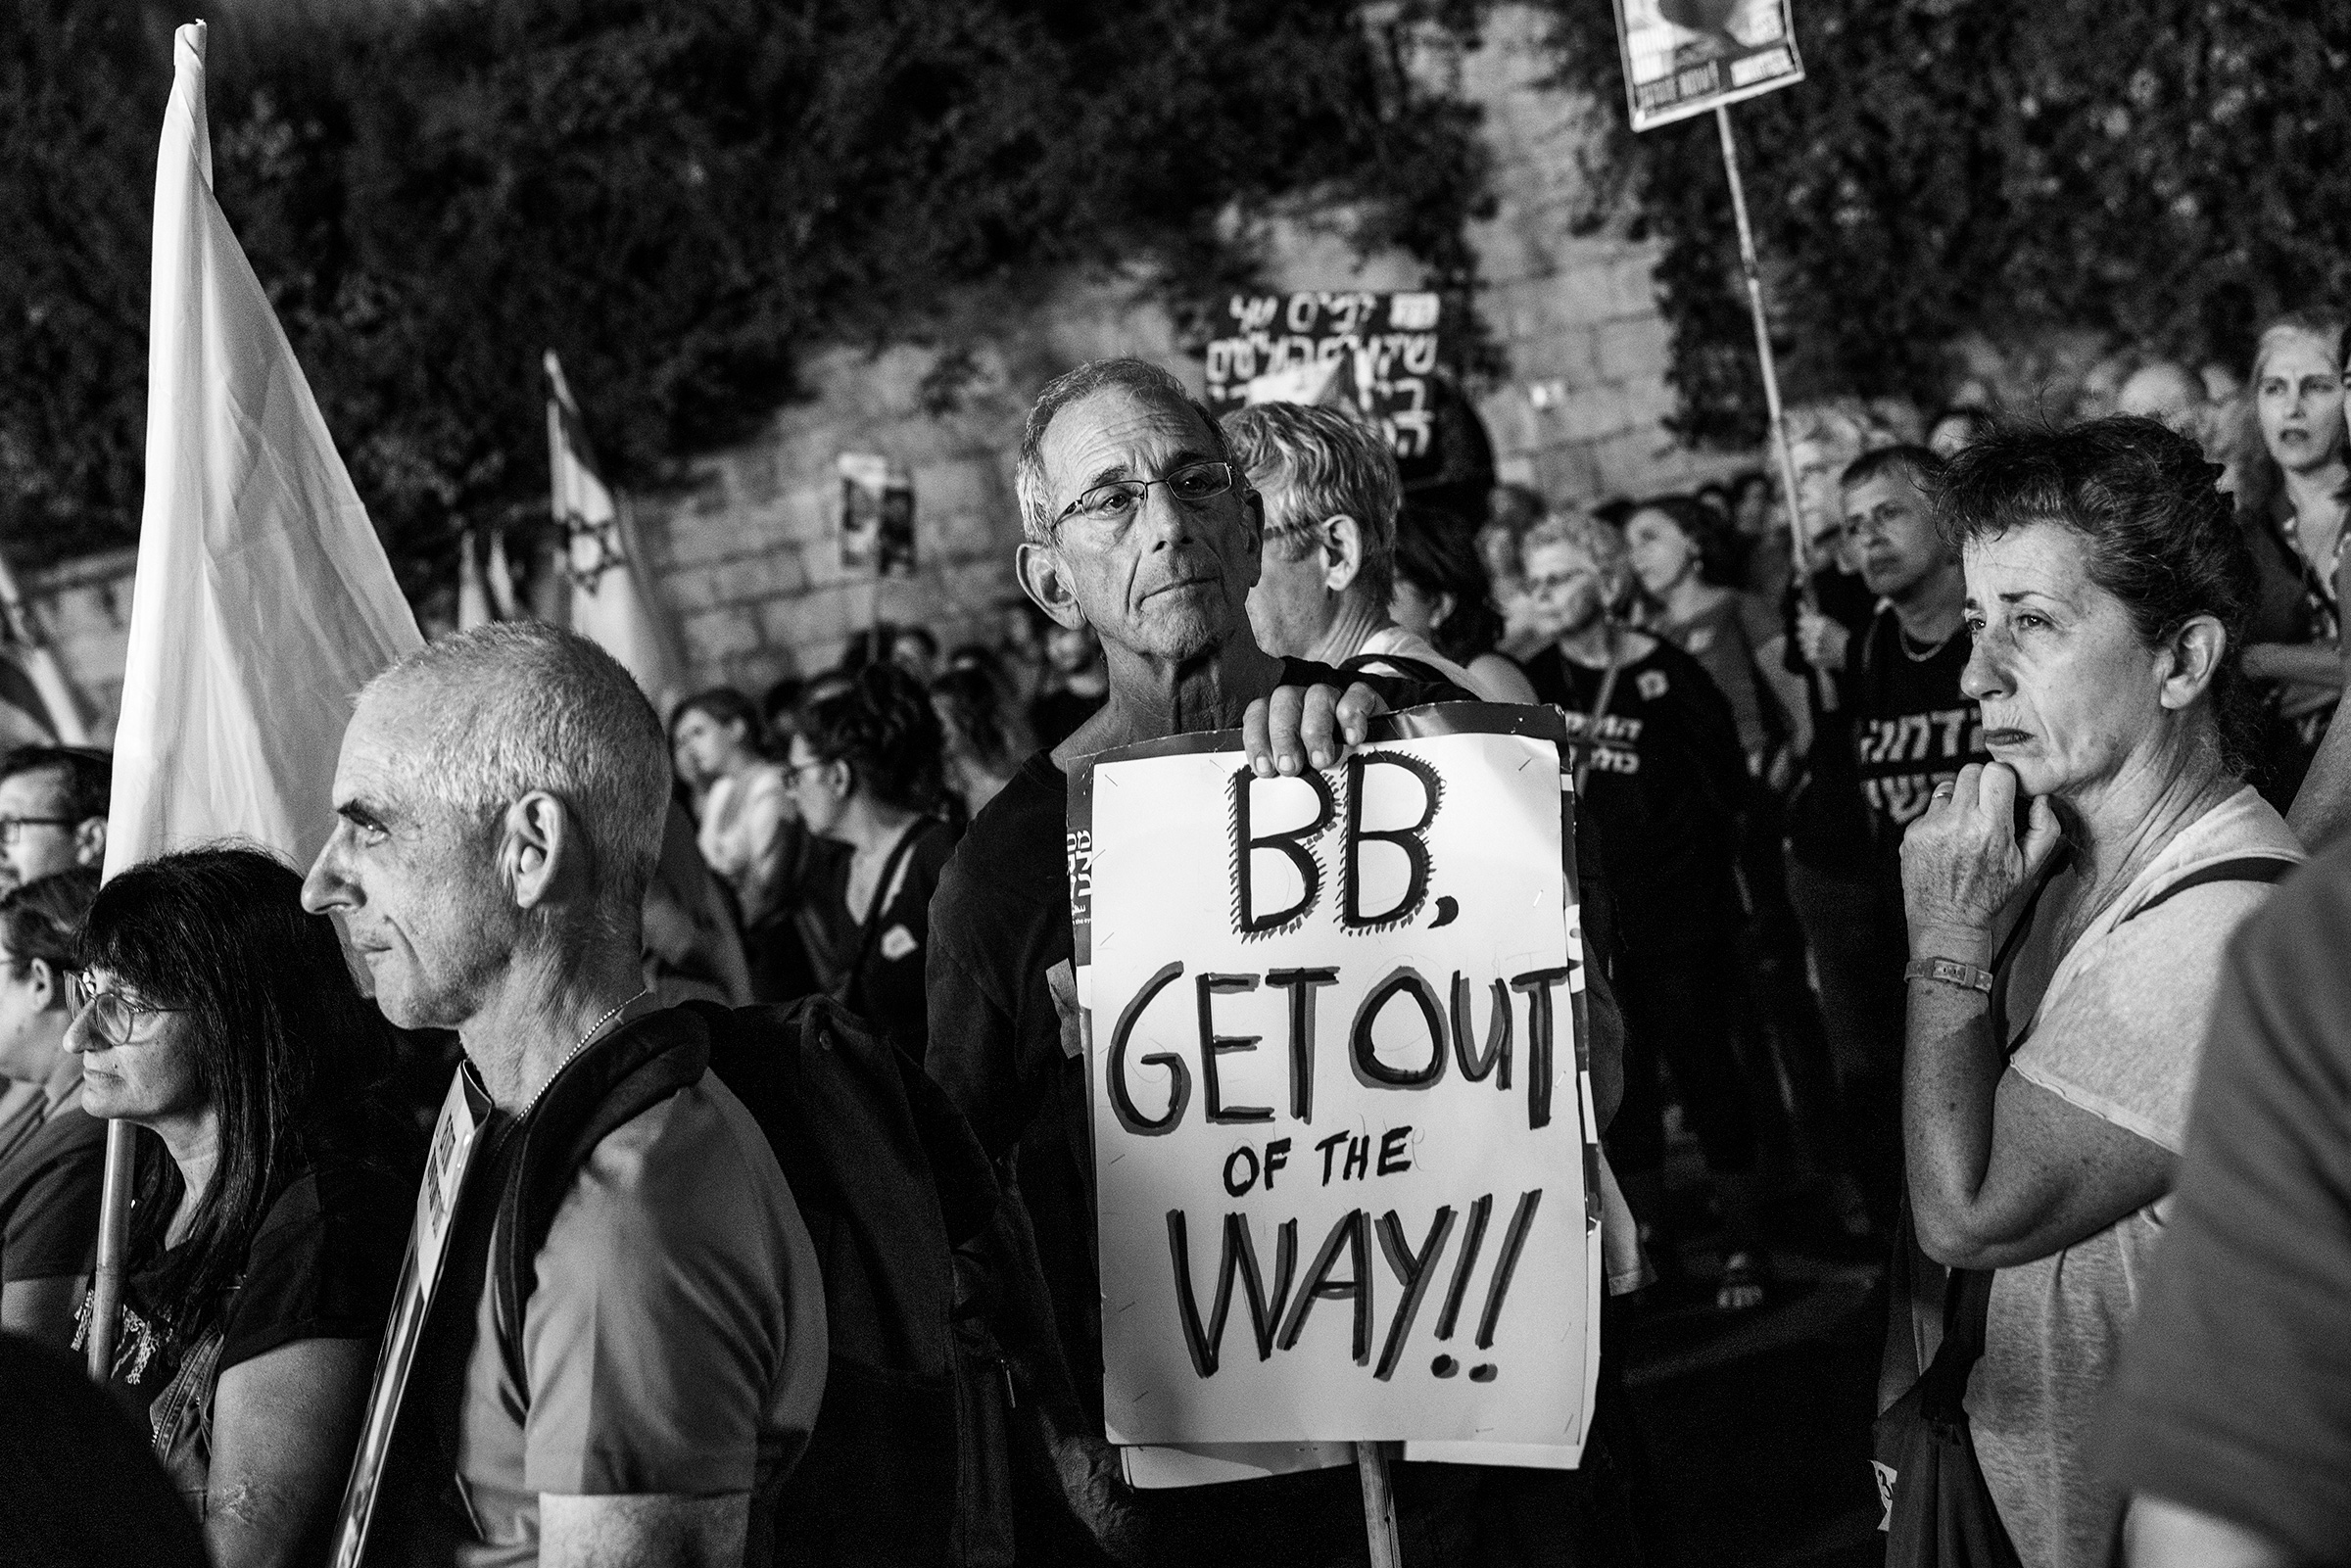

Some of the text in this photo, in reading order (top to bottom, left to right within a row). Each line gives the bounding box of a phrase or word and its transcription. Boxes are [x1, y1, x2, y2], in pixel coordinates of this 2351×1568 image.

[1227, 751, 1459, 942] BB,
[1106, 960, 1569, 1136] GET OUT
[1222, 1125, 1414, 1198] OF THE
[1166, 1188, 1543, 1383] WAY!!
